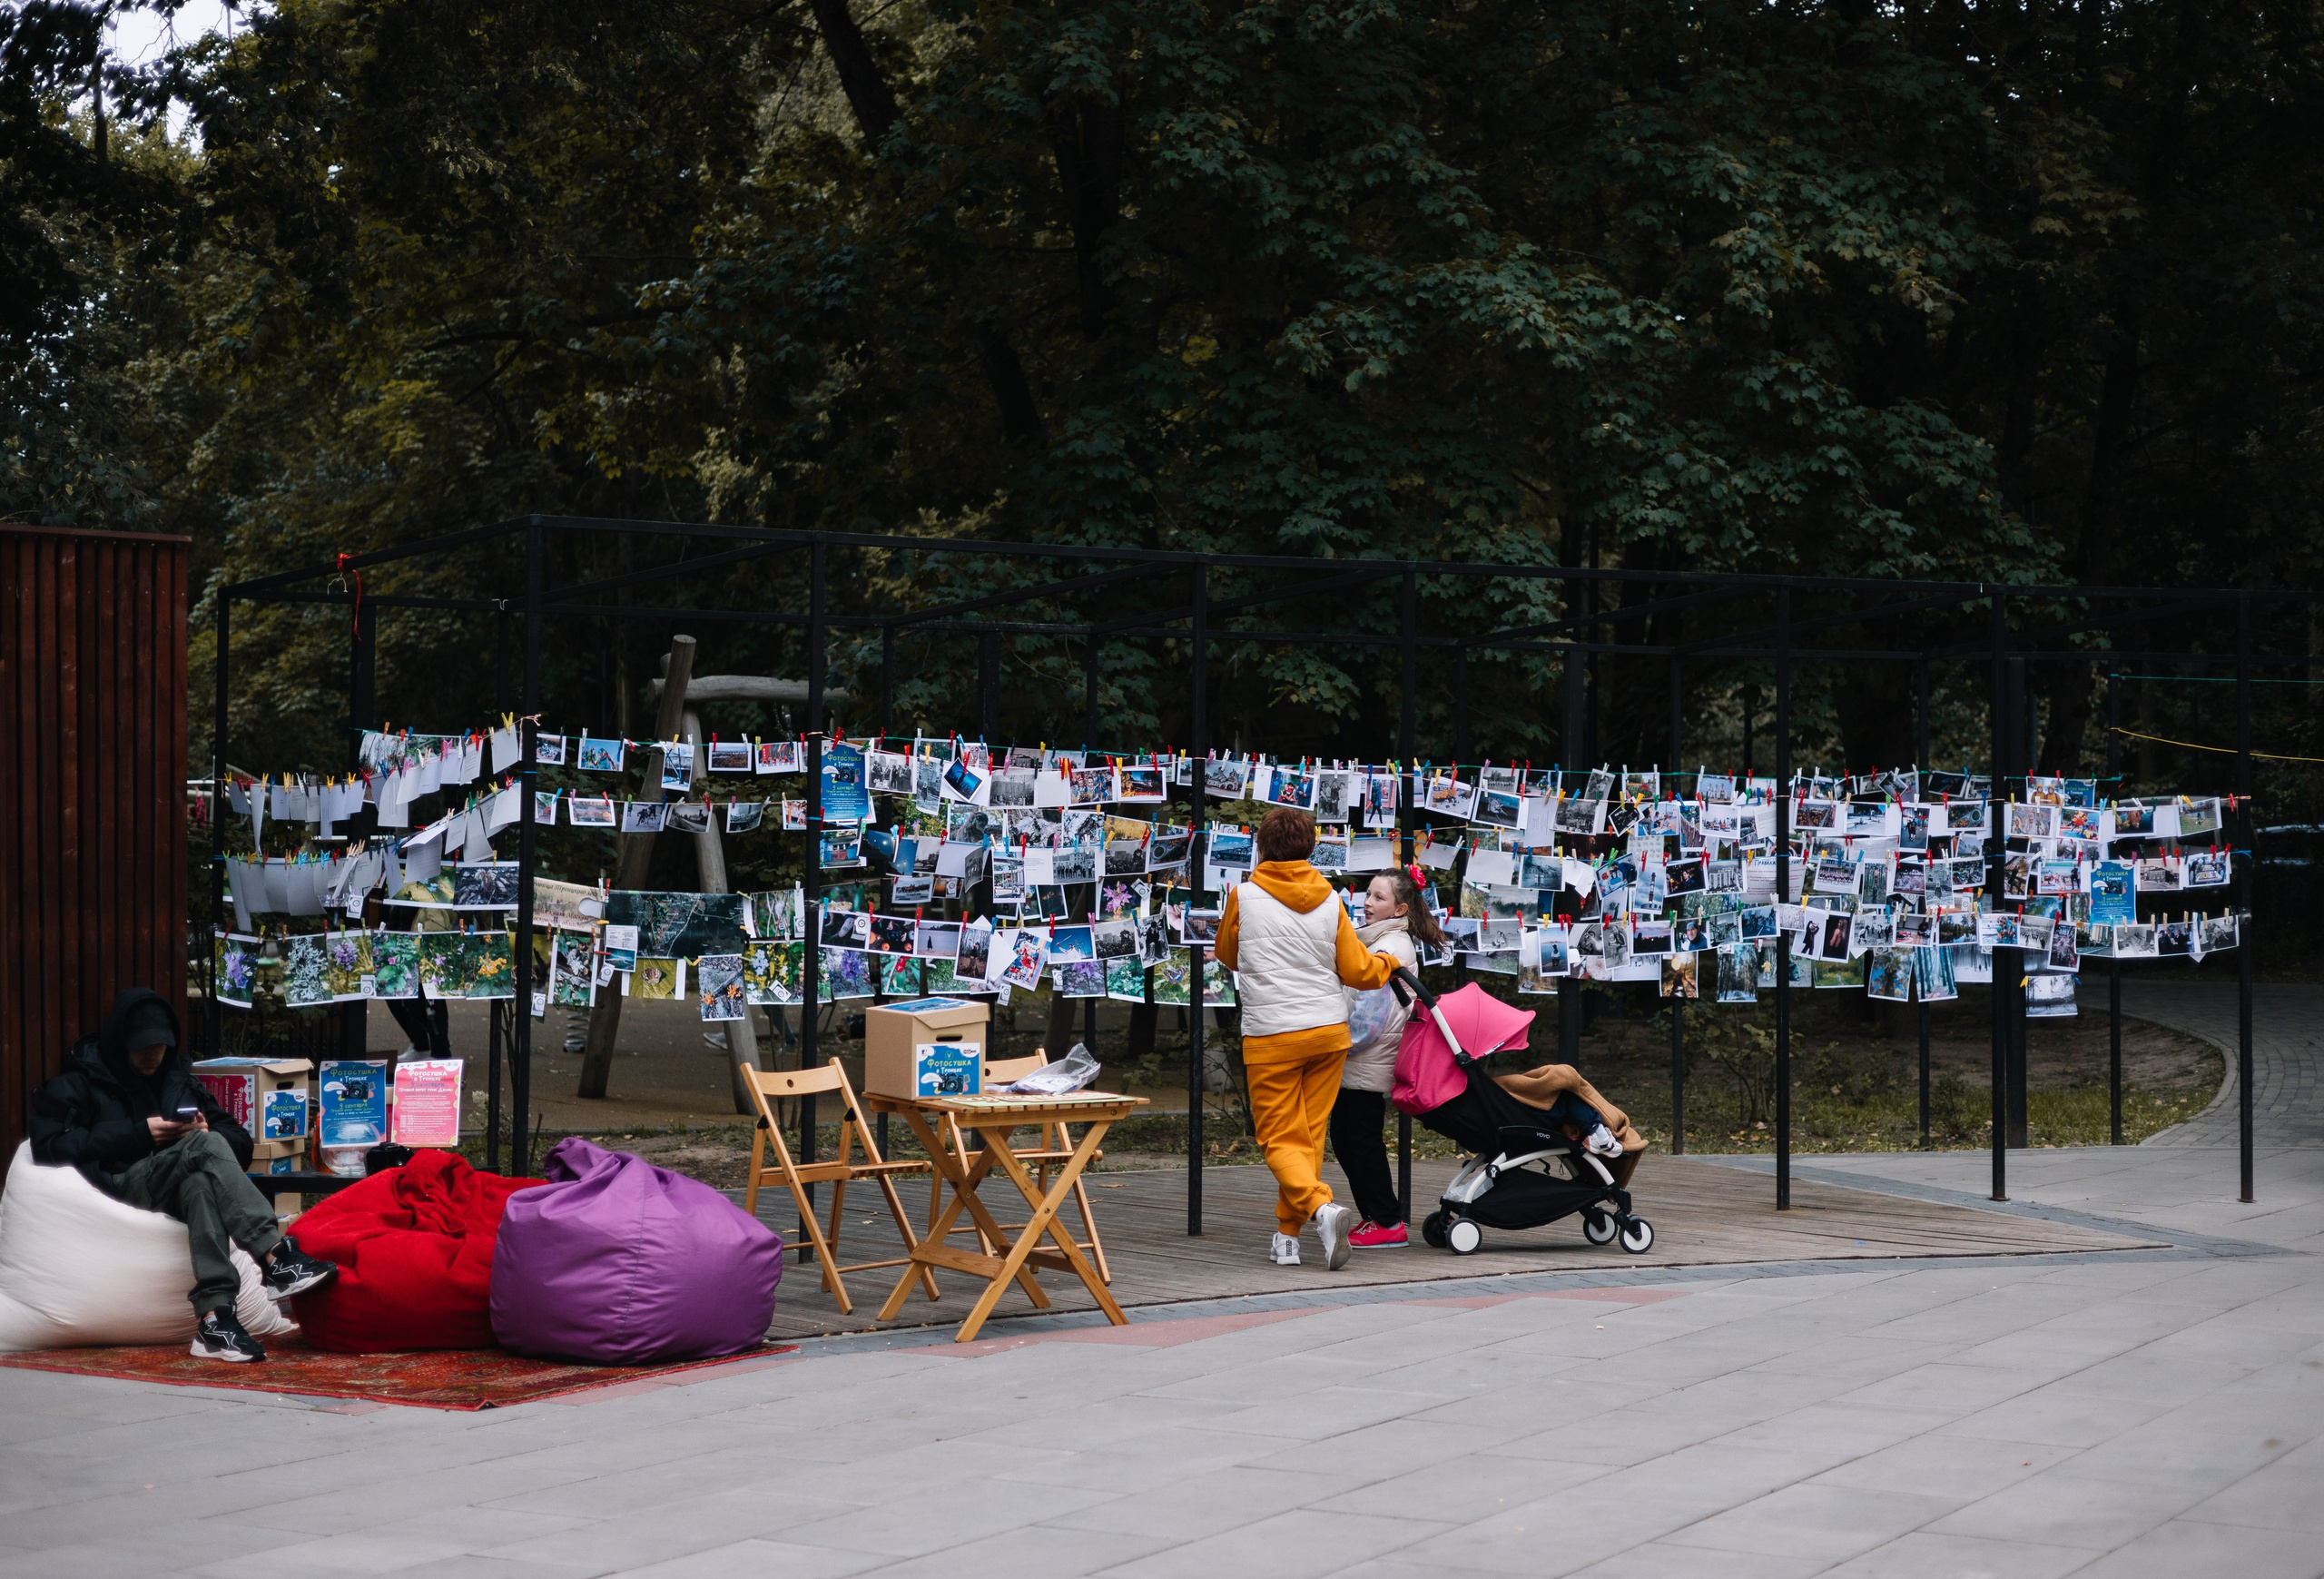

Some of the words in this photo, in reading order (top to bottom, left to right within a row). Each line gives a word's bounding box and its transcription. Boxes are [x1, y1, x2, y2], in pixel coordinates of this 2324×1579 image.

[927, 1059, 972, 1069] ФОТОСУШКА
[330, 1069, 378, 1078] ФОТОСУШКА
[408, 1070, 448, 1078] ФОТОСУШКА
[1536, 1131, 1551, 1140] YOYO
